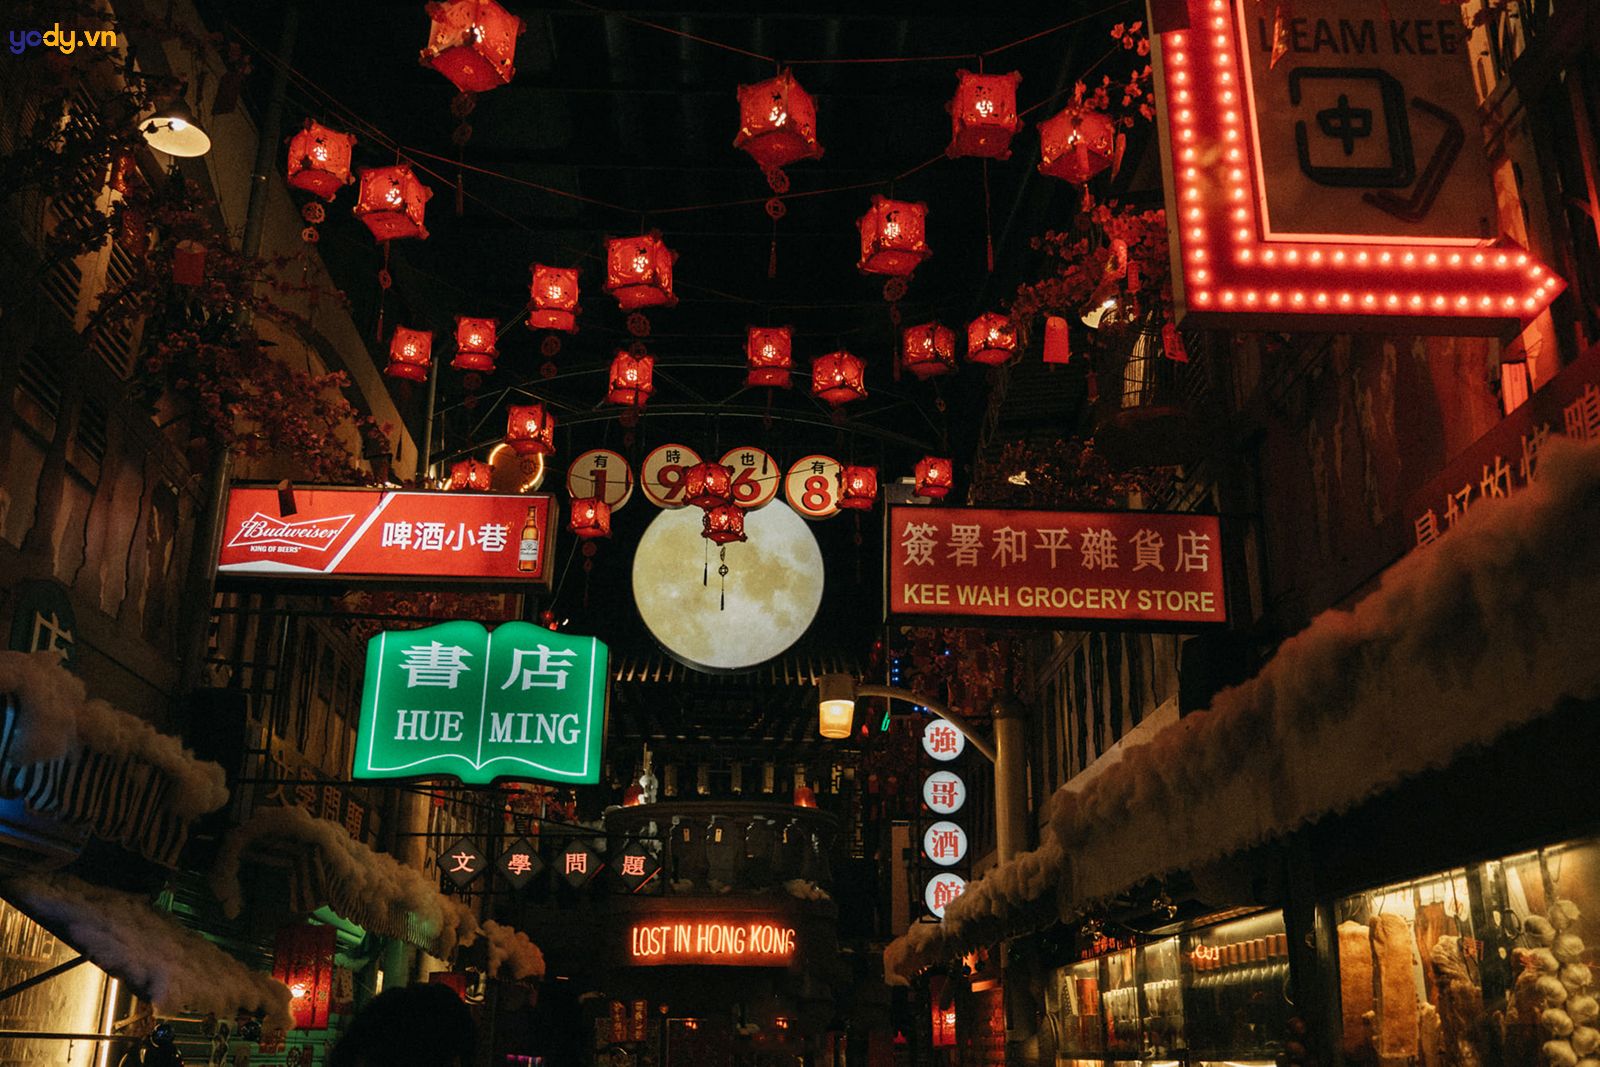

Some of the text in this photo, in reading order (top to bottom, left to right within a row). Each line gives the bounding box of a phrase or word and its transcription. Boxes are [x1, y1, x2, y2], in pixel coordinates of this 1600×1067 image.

[1390, 19, 1459, 55] KEE
[1316, 94, 1372, 156] 中
[242, 520, 338, 539] Budweiser
[381, 521, 508, 553] 啤酒小巷
[904, 583, 1216, 613] KEE WAH GROCERY STORE
[398, 640, 578, 691] 書店
[394, 709, 581, 745] HUE MING
[448, 850, 647, 877] 文學問題
[632, 924, 796, 956] LOST IN HONG KONG
